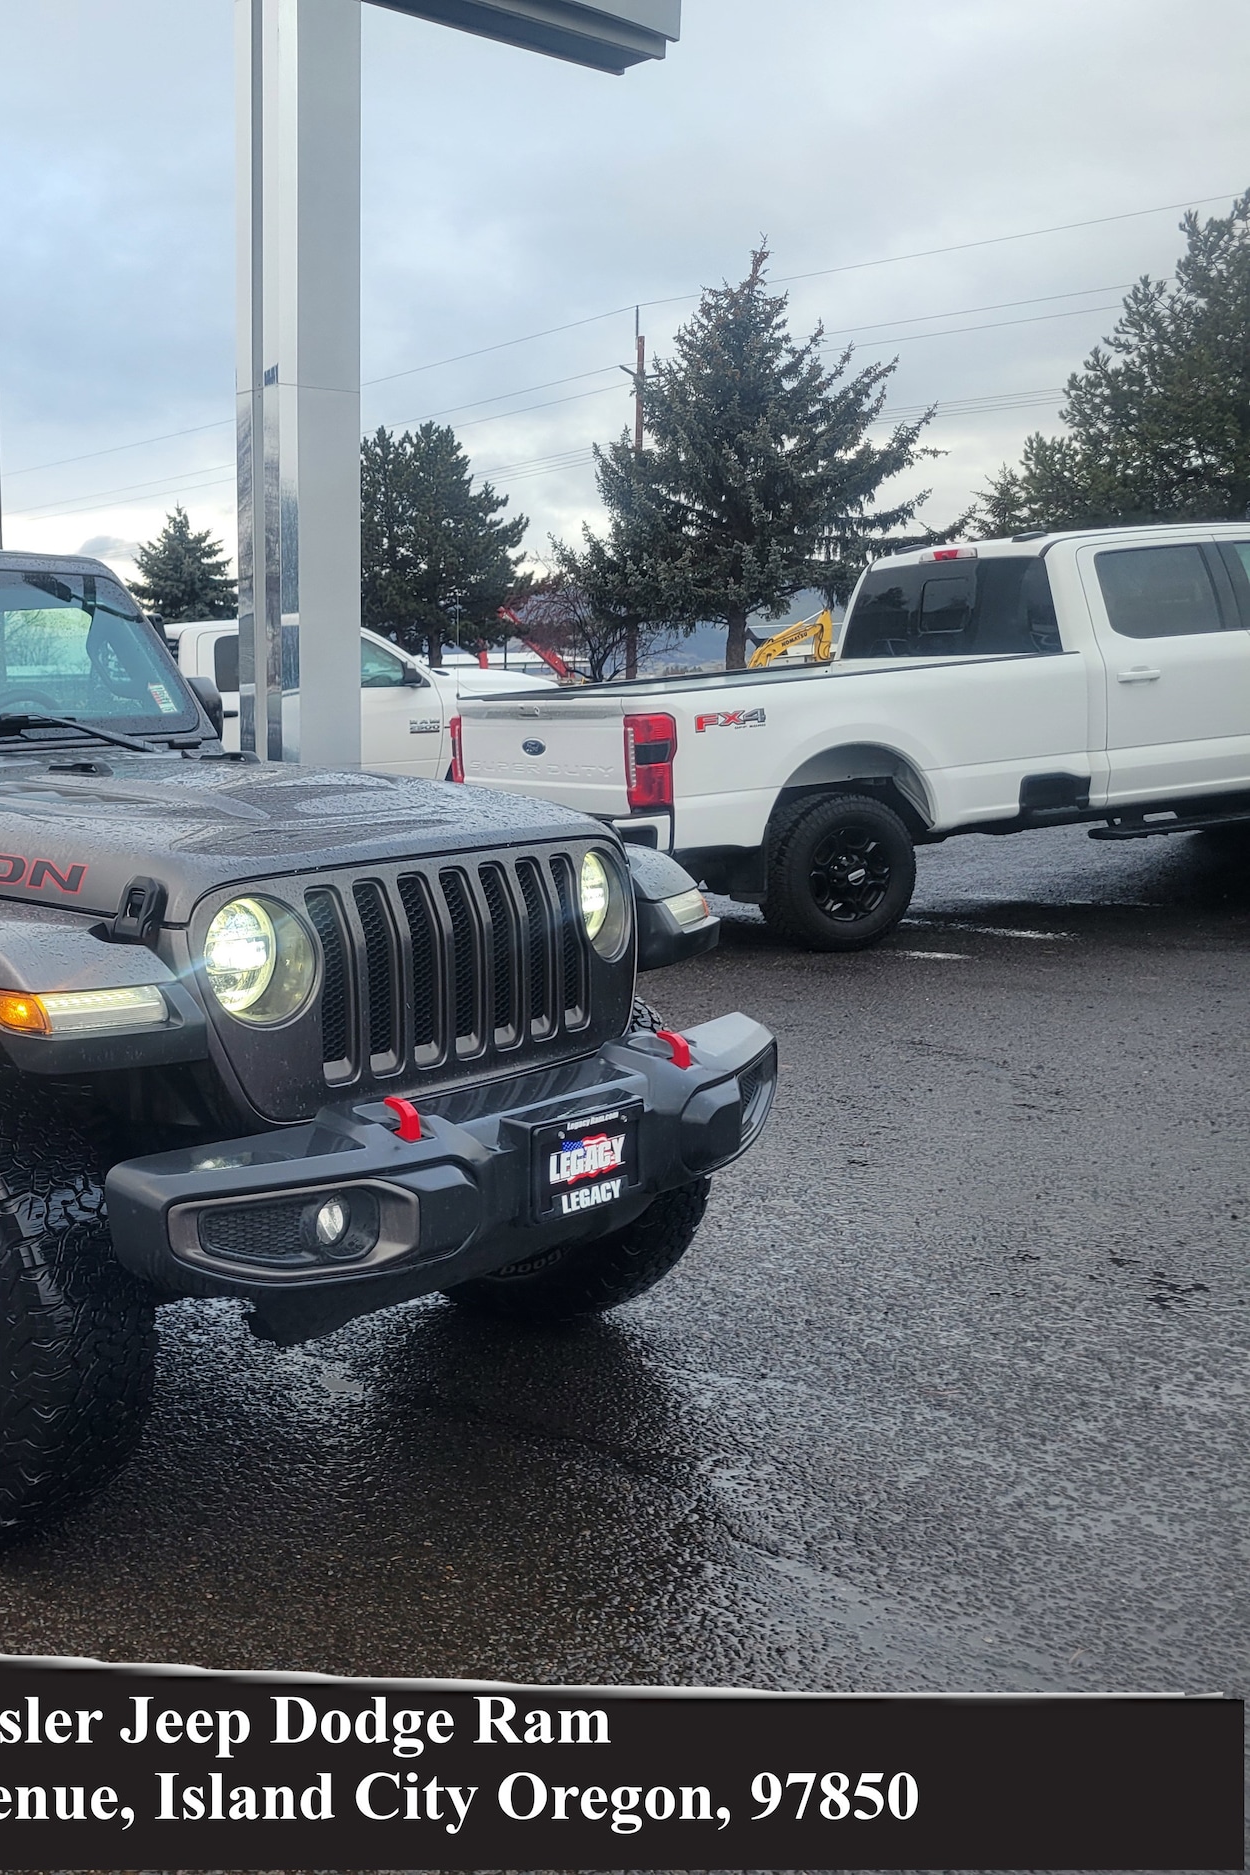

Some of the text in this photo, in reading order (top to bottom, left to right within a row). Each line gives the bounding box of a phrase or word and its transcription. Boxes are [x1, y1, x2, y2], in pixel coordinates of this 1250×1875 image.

[695, 708, 766, 733] FX4
[469, 760, 615, 778] SUPER DUTY
[550, 1136, 625, 1182] LEGACY
[561, 1179, 621, 1214] LEGACY
